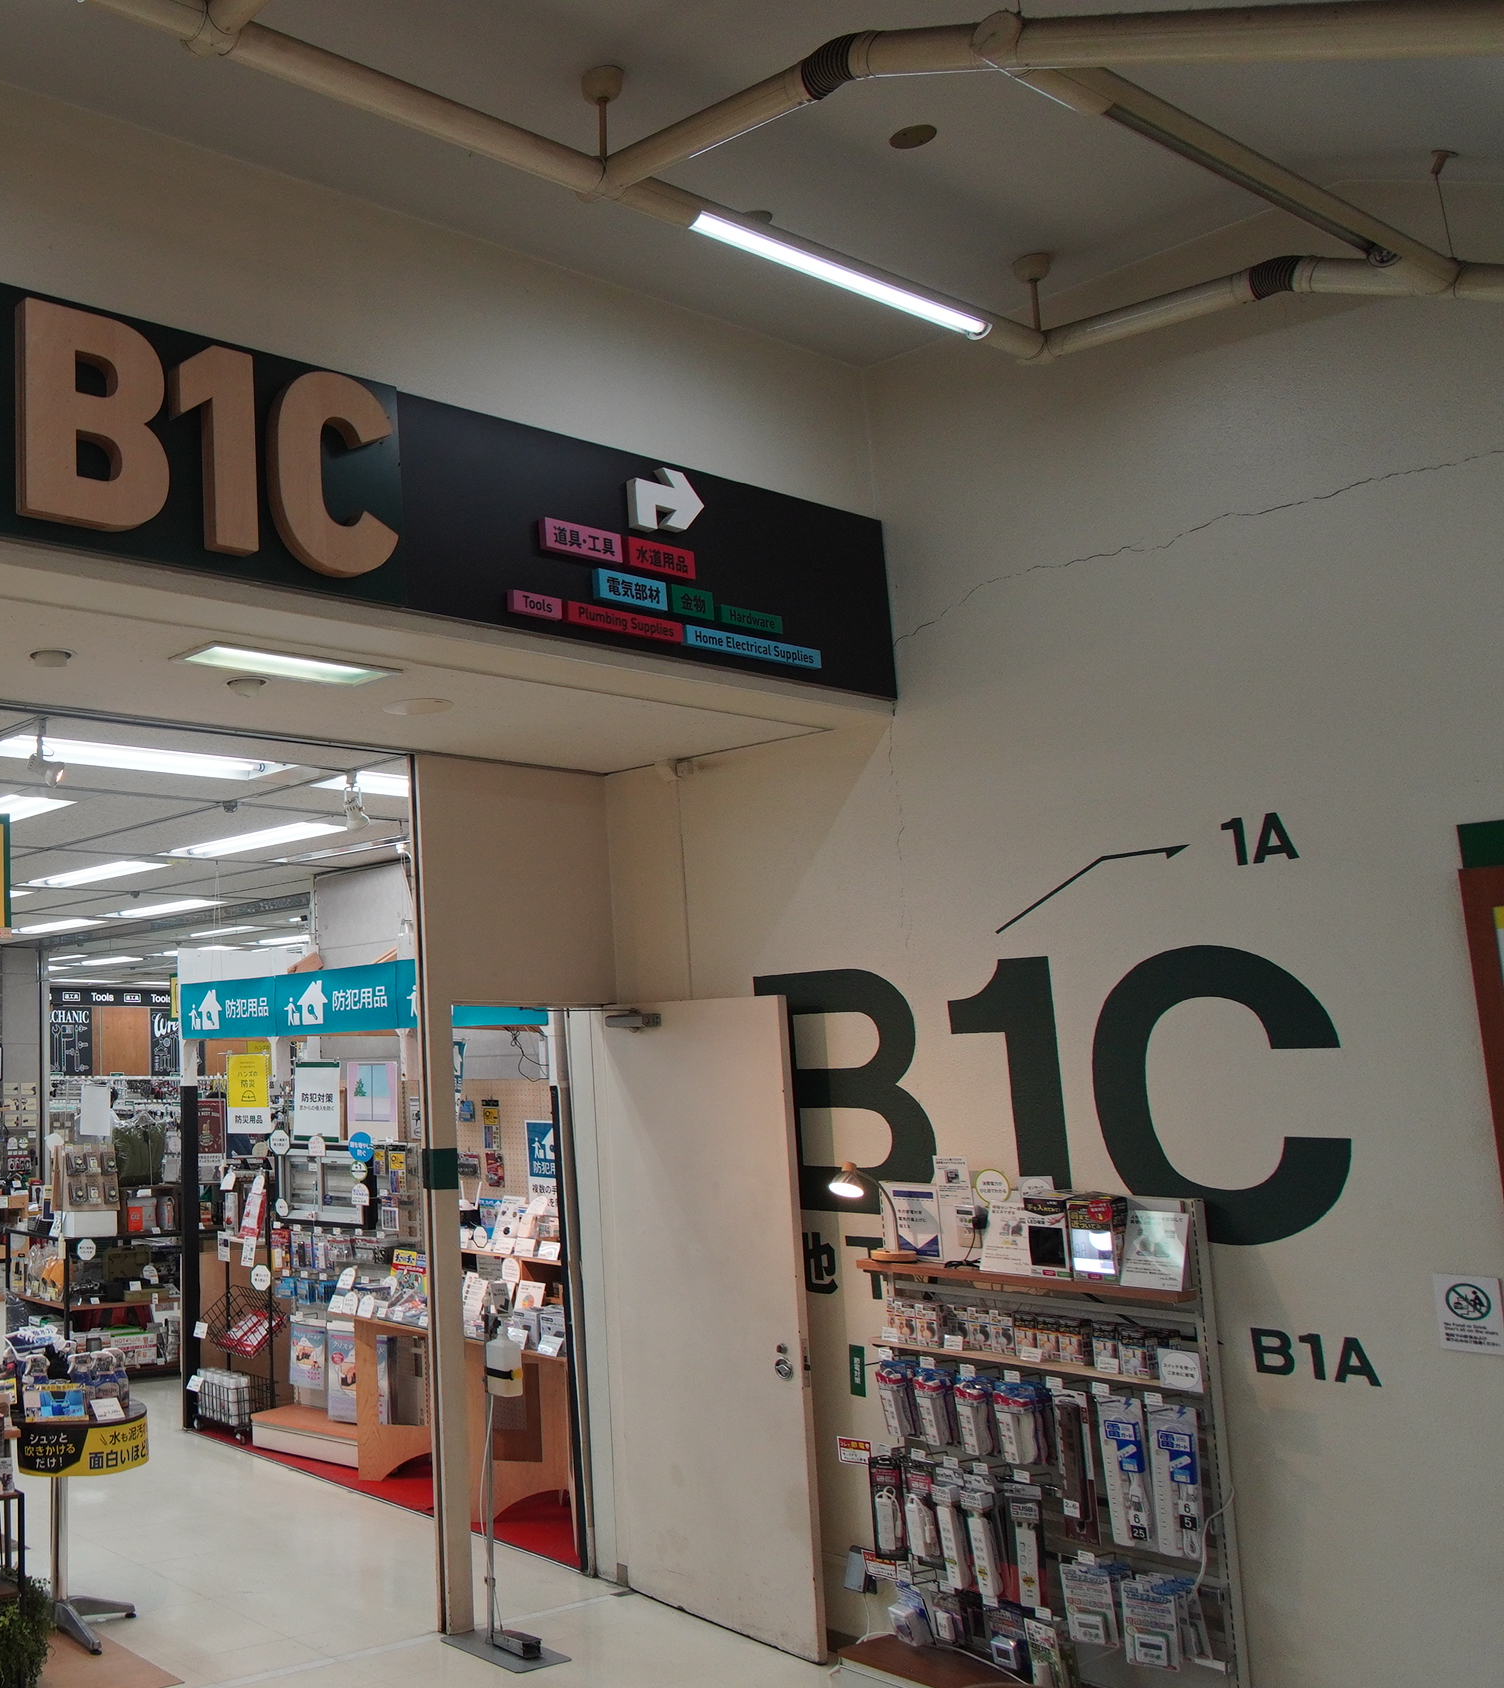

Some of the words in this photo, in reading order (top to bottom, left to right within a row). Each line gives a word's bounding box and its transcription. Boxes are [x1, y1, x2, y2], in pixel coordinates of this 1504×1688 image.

[15, 296, 399, 579] B1C
[553, 526, 616, 557] 道具・工具
[636, 545, 689, 574] 水道用品
[606, 576, 661, 605] 電気部材
[522, 595, 553, 613] Tools
[680, 592, 706, 614] 金物
[578, 606, 628, 631] Plumbing
[630, 617, 674, 639] Supplies
[729, 610, 776, 630] Hardware
[694, 630, 723, 647] Home
[726, 636, 771, 656] Electrical
[773, 643, 815, 665] Supplies
[1220, 811, 1300, 867] 1A
[90, 992, 115, 1002] Tools
[225, 997, 269, 1019] 防犯用品
[332, 986, 388, 1012] 防犯用品
[49, 1010, 89, 1024] CHANIC
[153, 1013, 180, 1038] Wre
[237, 1070, 258, 1078] ハンズの
[240, 1079, 256, 1088] 防災
[301, 1092, 334, 1104] 防犯対策
[753, 944, 1352, 1246] B1C
[234, 1114, 263, 1124] 防災用品
[533, 1160, 556, 1175] 防犯用
[1249, 1326, 1382, 1388] B1A
[29, 1432, 68, 1444] シュッと
[109, 1423, 147, 1446] 水も泥汚
[24, 1443, 76, 1457] 吹きかける
[88, 1441, 148, 1470] 面白いほど
[965, 1493, 980, 1502] USB
[1018, 1505, 1033, 1513] USB
